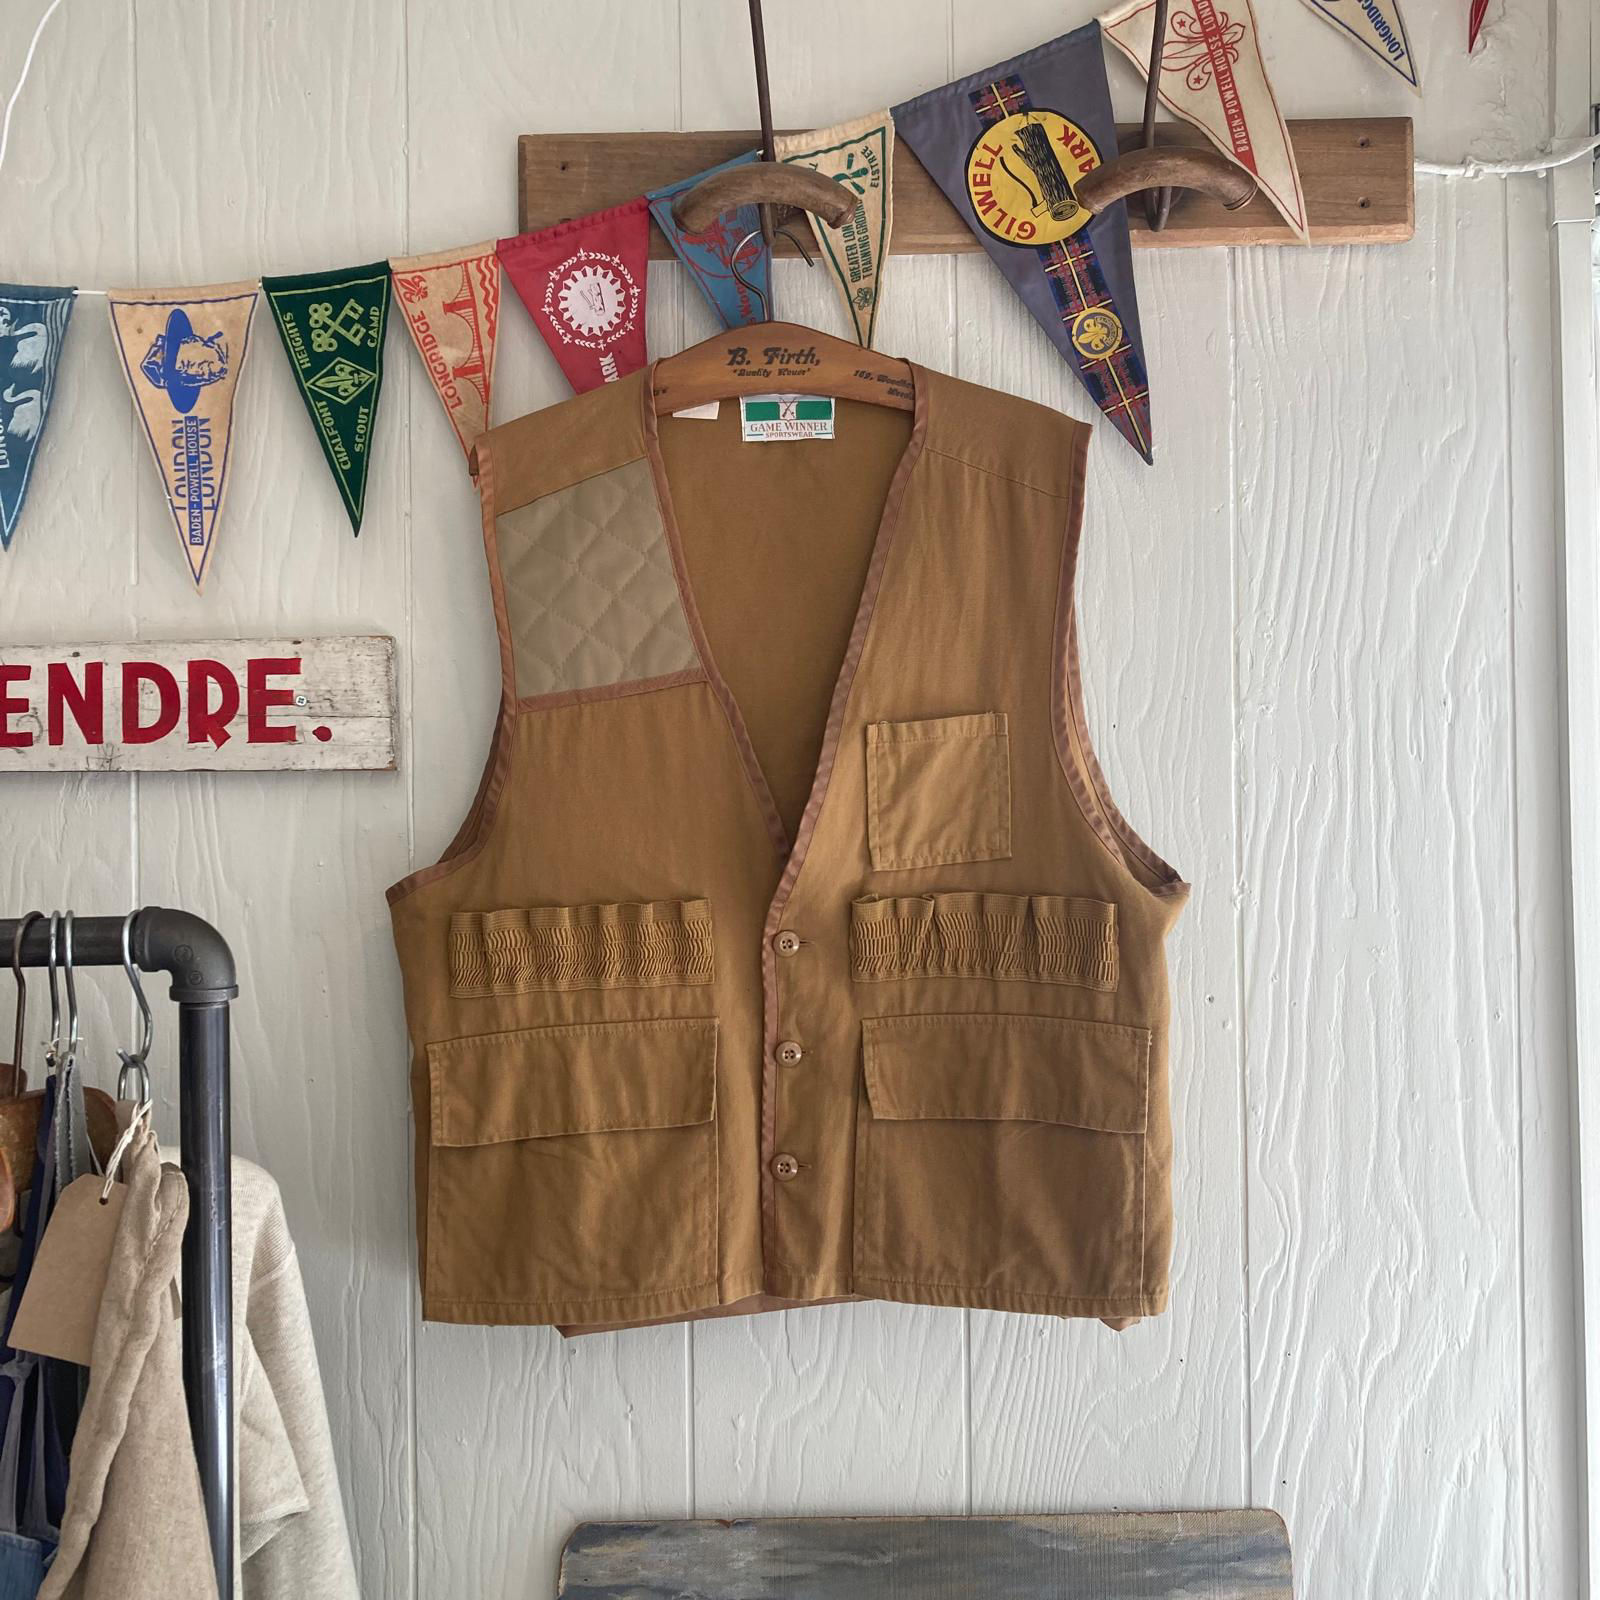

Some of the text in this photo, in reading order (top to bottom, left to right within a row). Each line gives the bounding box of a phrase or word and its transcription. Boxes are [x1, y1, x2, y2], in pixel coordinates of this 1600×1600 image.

[1357, 0, 1405, 61] LONGRIDG
[1196, 0, 1249, 153] BADEN-POWELL HOUSE LOND
[860, 145, 880, 189] ELSTREE
[972, 124, 1096, 240] GILWELL ARK
[845, 243, 862, 283] GREATER
[854, 200, 873, 280] TRAINING GROUN
[283, 312, 352, 471] CHALFONT HEIGHTS
[411, 310, 463, 409] LONGRIDGE
[727, 347, 821, 366] B. Firth,
[354, 406, 370, 452] SCOUT
[750, 422, 827, 432] GAME WINNER
[187, 420, 202, 544] BADEN-POWELL HOUSE
